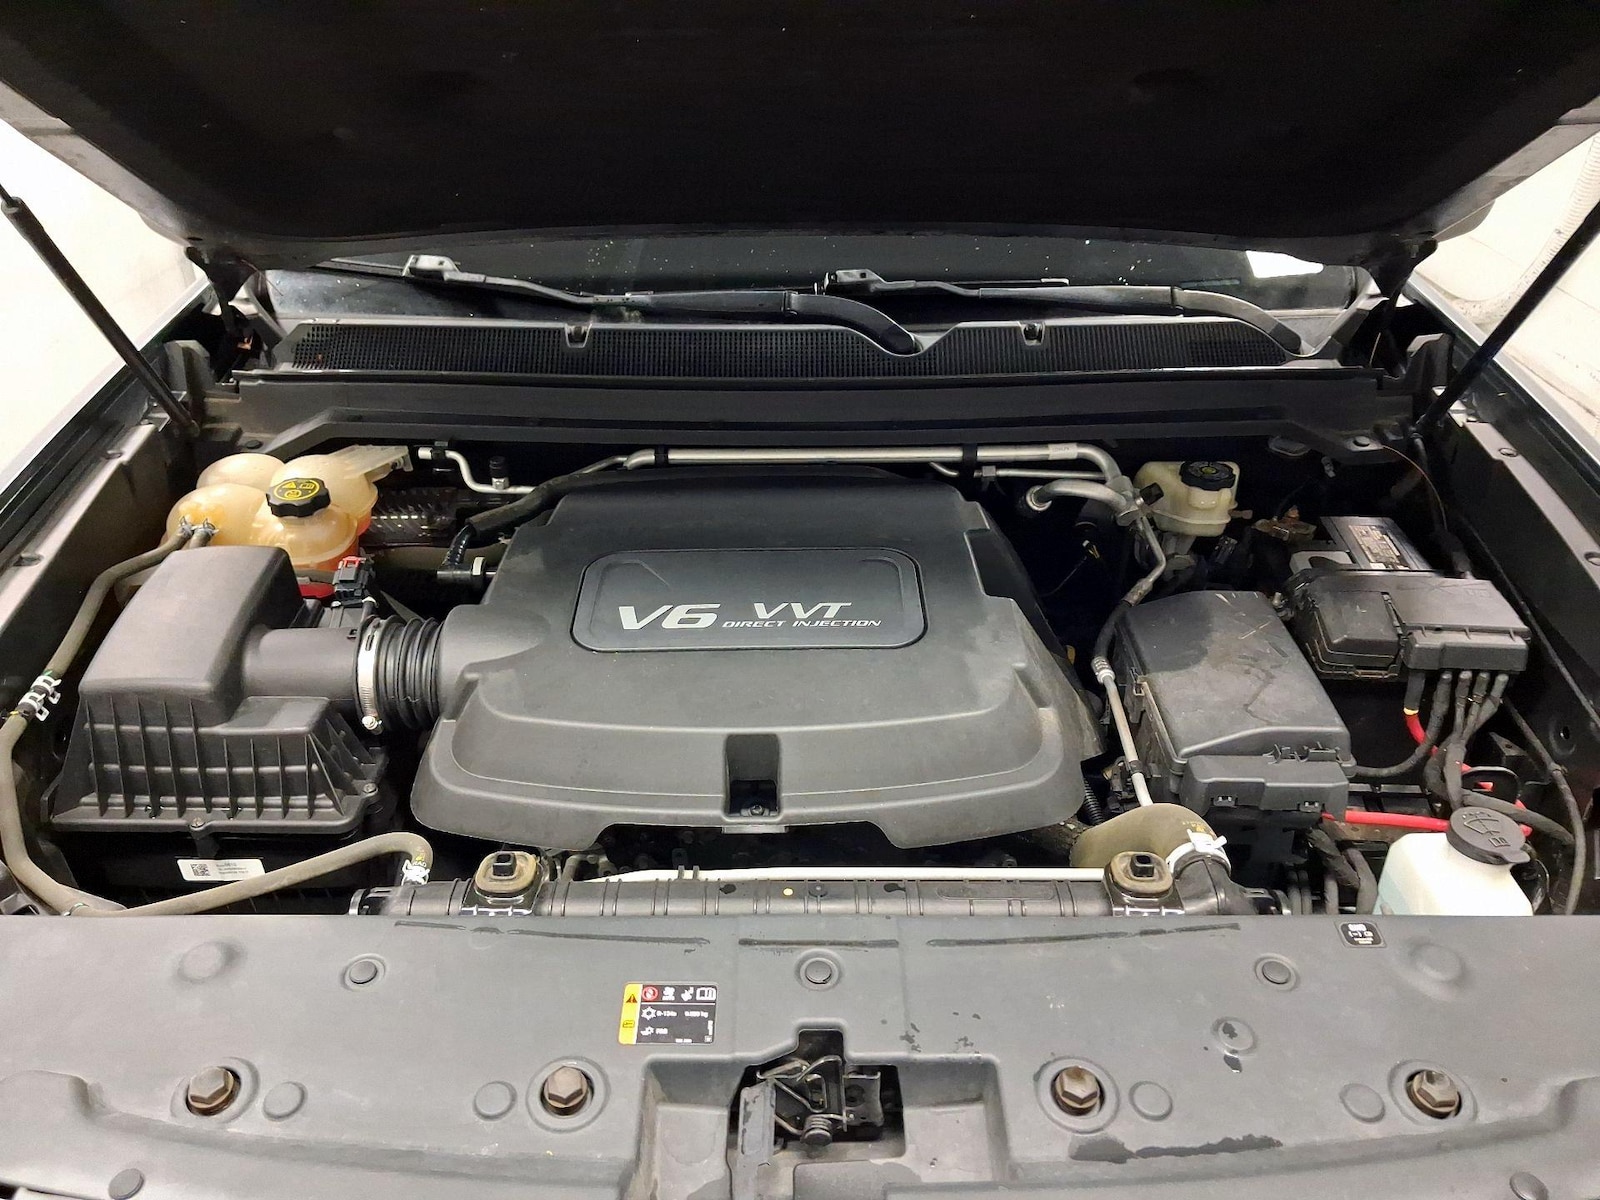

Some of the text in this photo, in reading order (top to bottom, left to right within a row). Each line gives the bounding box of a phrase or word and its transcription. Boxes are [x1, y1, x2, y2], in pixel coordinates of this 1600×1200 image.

[618, 603, 721, 630] V6
[753, 602, 852, 619] VVT
[721, 619, 882, 628] DIRECT INJECTION
